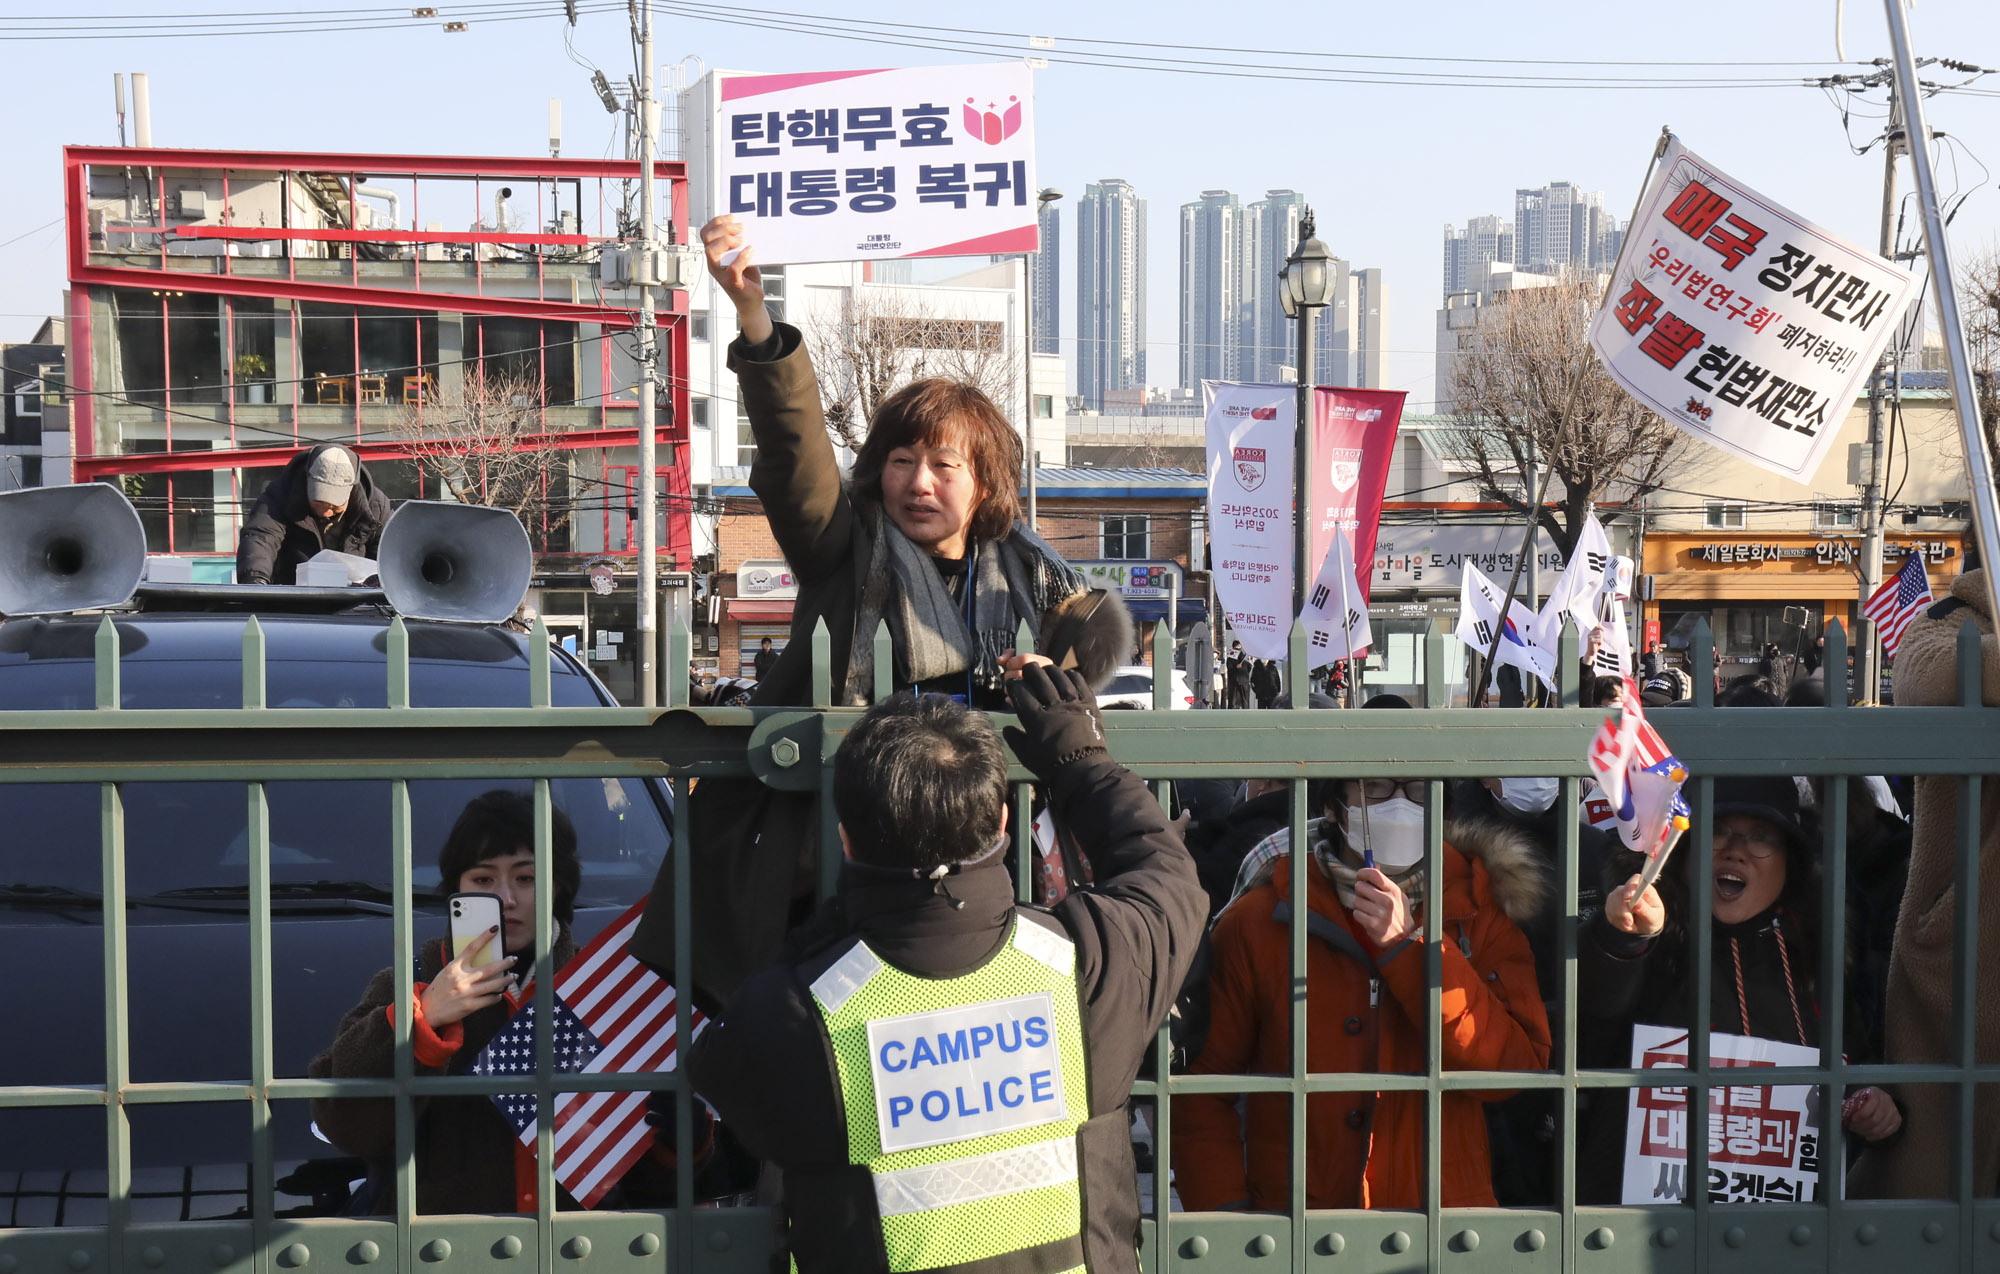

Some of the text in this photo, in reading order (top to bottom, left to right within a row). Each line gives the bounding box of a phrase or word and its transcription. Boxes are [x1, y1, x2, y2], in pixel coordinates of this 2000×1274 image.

[731, 102, 954, 158] 탄핵무효
[730, 160, 1028, 218] 대통령 복귀
[856, 241, 902, 251] 국민변호인단
[867, 234, 892, 242] 대통령
[1663, 179, 1891, 332] 매국 정치판사
[1612, 278, 1830, 438] 좌빨 헌법재판소
[1777, 321, 1858, 374] 폐지하라!!
[1702, 543, 1782, 563] 제일문화사
[880, 1016, 1049, 1073] CAMPUS
[889, 1070, 1054, 1128] POLICE
